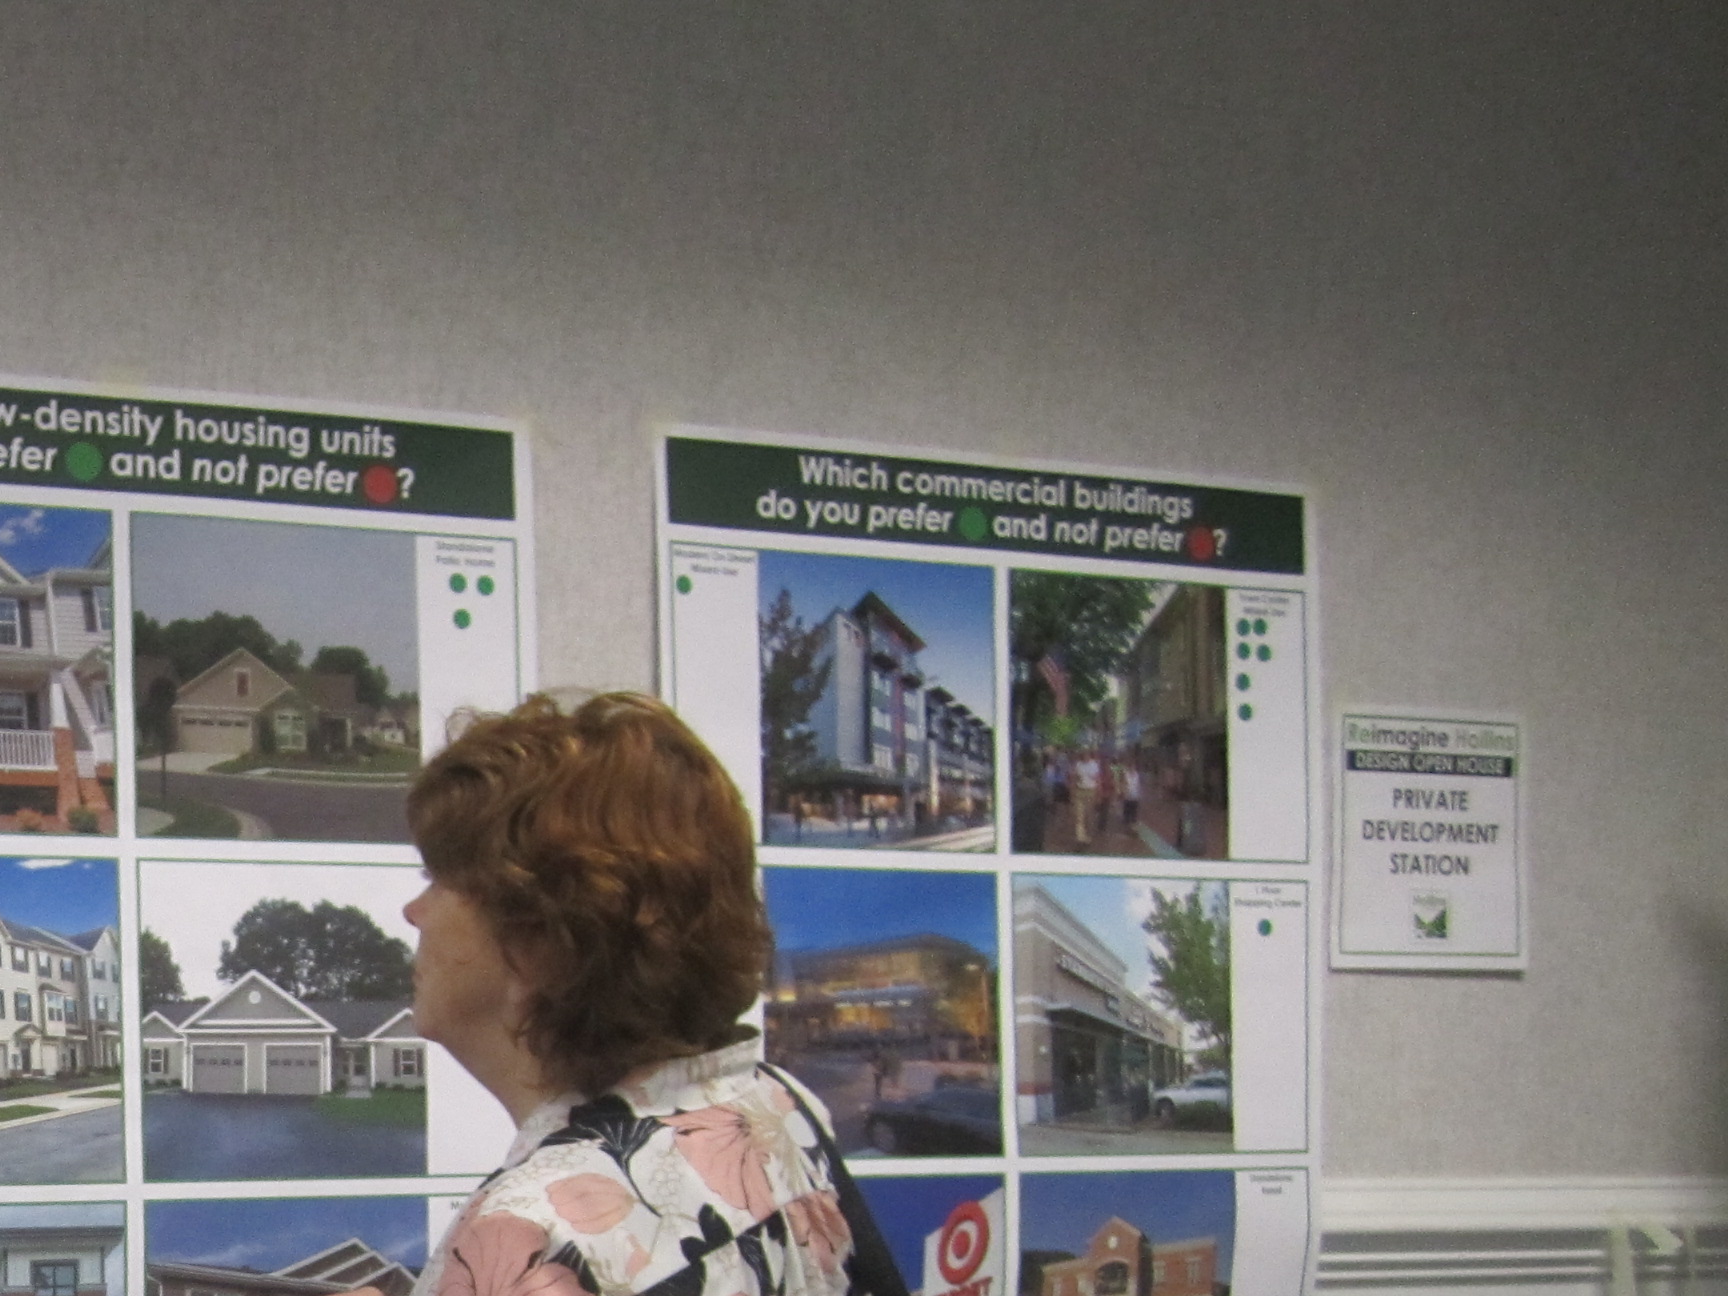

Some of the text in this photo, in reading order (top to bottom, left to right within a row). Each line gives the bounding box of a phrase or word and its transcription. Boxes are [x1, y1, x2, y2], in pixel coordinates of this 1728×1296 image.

[174, 408, 310, 458] housing
[321, 424, 396, 458] units
[109, 449, 181, 481] and
[192, 453, 249, 485] not
[255, 460, 358, 496] prefer
[797, 454, 1194, 525] Which commercial buildings
[755, 488, 797, 520] do
[804, 499, 861, 529] you
[867, 502, 954, 533] prefer
[992, 514, 1047, 541] and
[1054, 518, 1099, 545] not
[1104, 522, 1184, 553] prefer
[1392, 788, 1470, 811] PRIVATE
[1362, 819, 1500, 843] DEVELOPMENT
[1389, 853, 1470, 875] STATION
